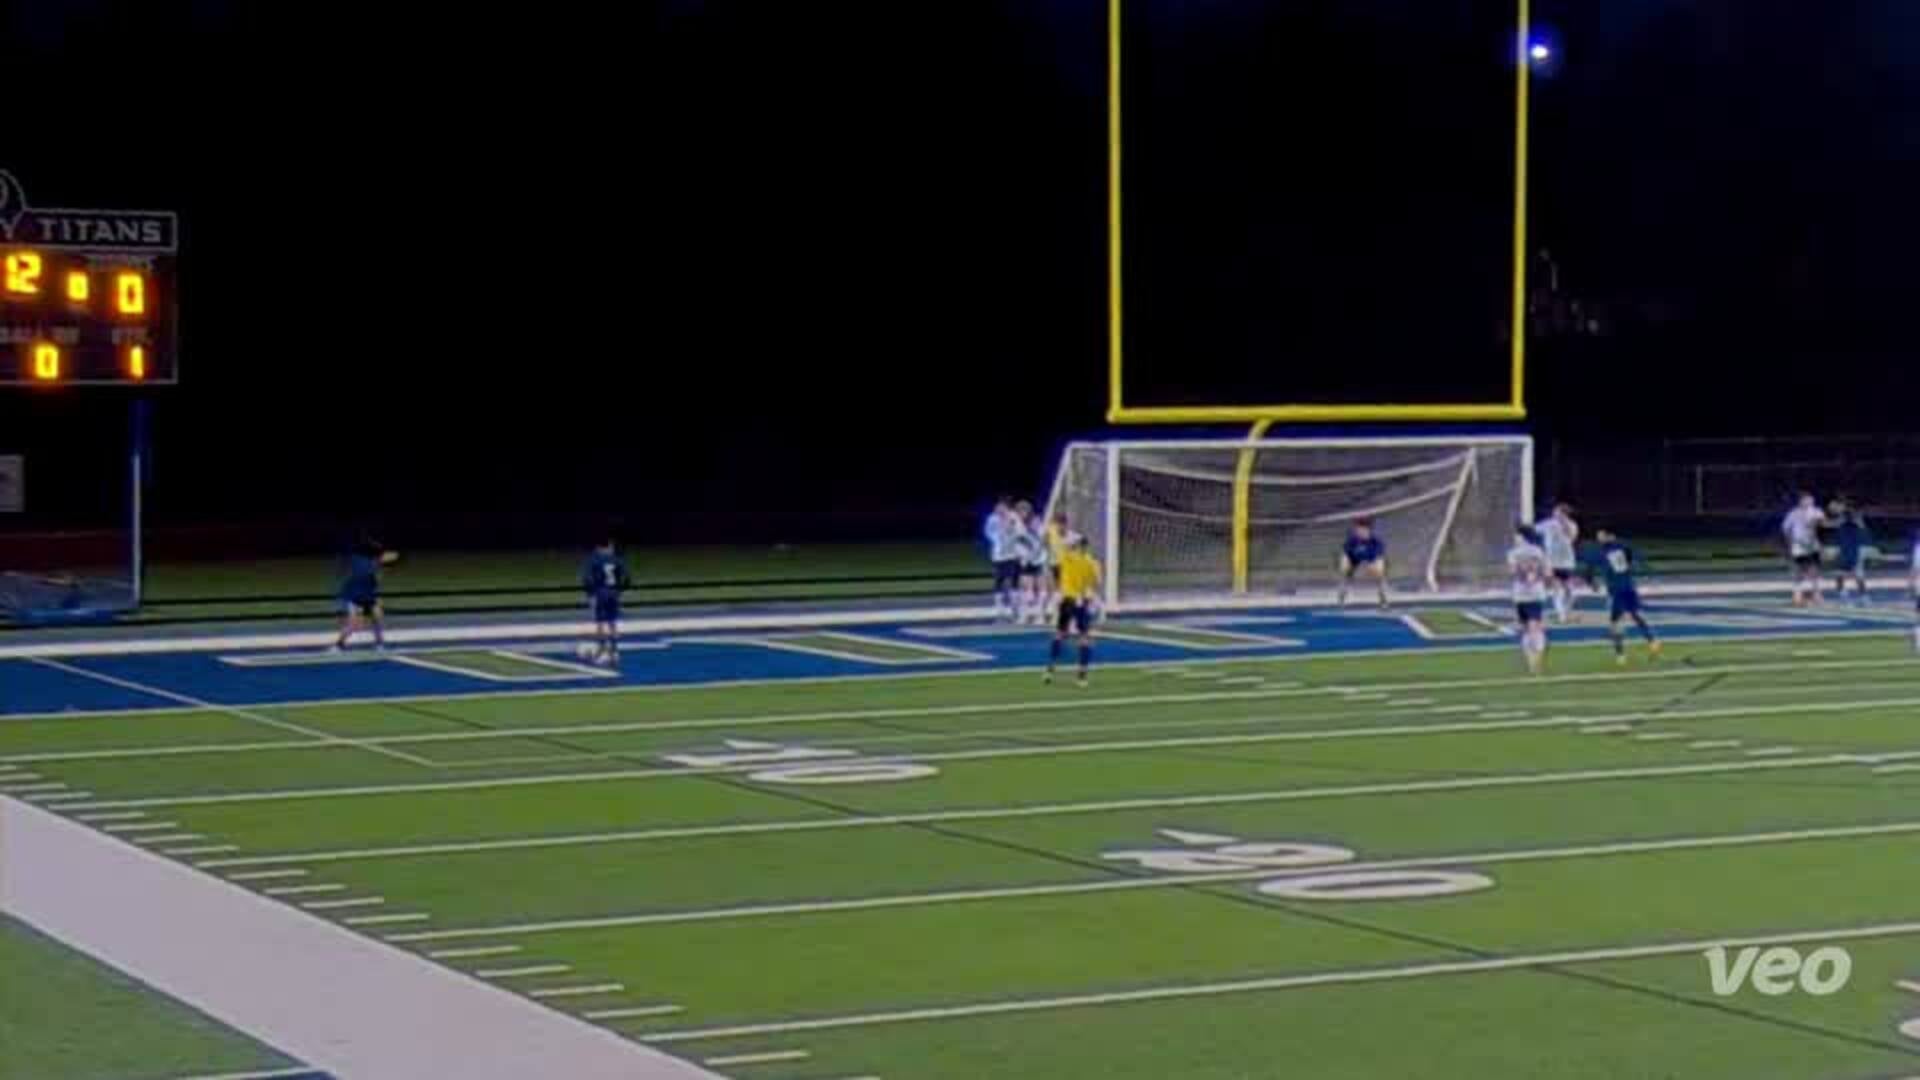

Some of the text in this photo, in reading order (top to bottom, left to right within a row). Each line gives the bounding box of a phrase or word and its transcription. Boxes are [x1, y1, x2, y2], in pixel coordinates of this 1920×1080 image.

[36, 218, 161, 242] TITANS
[118, 274, 143, 313] 0
[35, 344, 58, 379] 0
[131, 346, 143, 377] 1
[1101, 842, 1495, 899] 20
